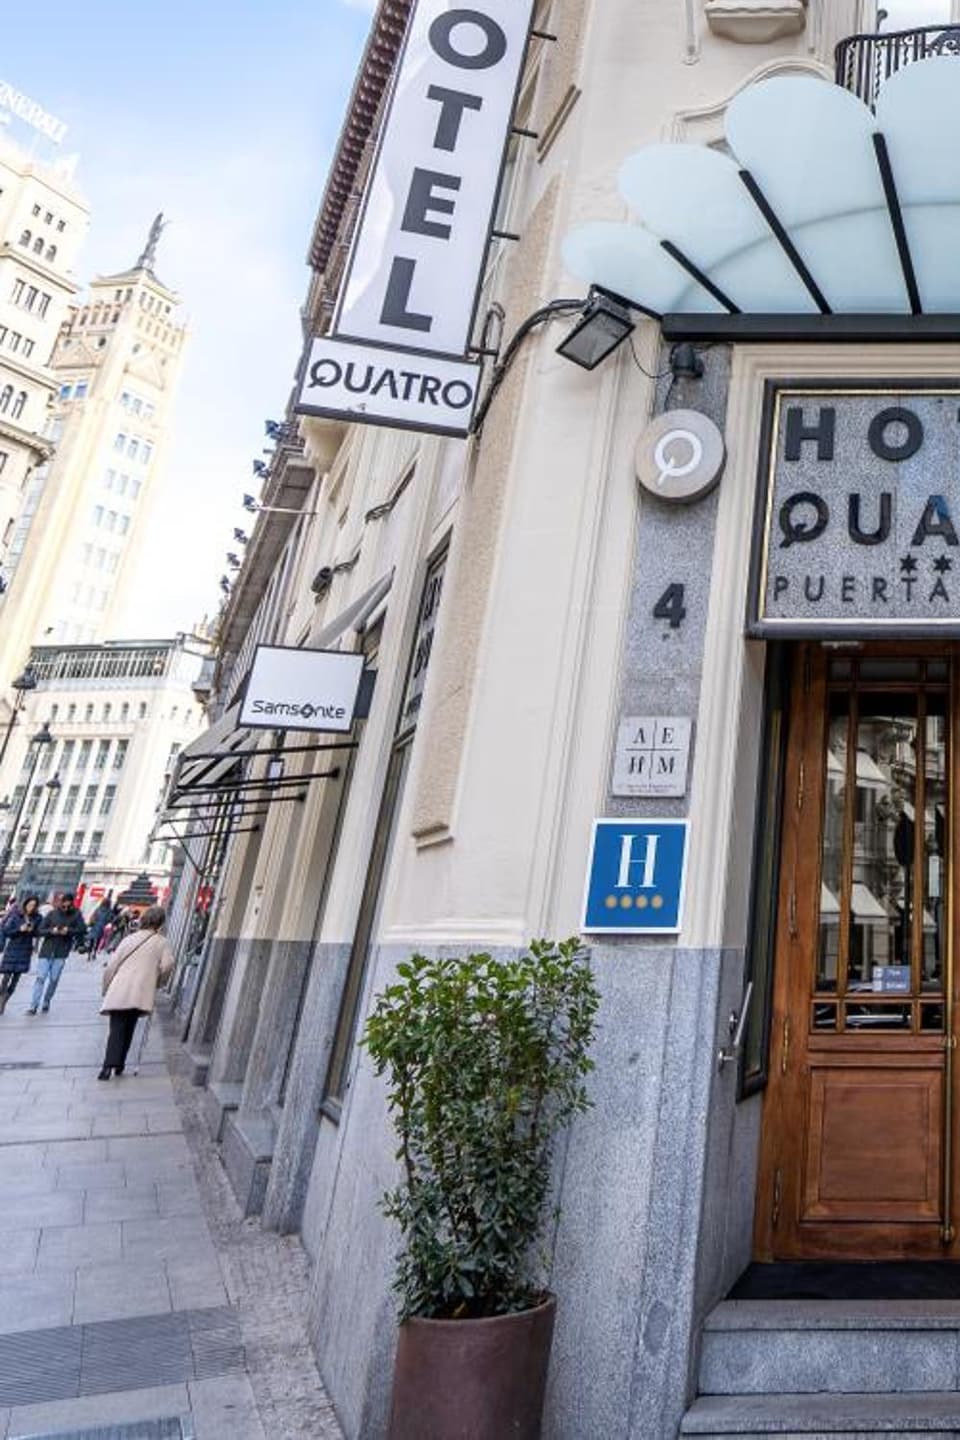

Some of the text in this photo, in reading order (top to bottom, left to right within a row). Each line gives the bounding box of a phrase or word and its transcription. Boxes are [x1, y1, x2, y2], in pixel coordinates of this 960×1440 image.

[307, 358, 473, 410] QUATRO
[653, 582, 686, 629] 4
[614, 834, 661, 888] H
